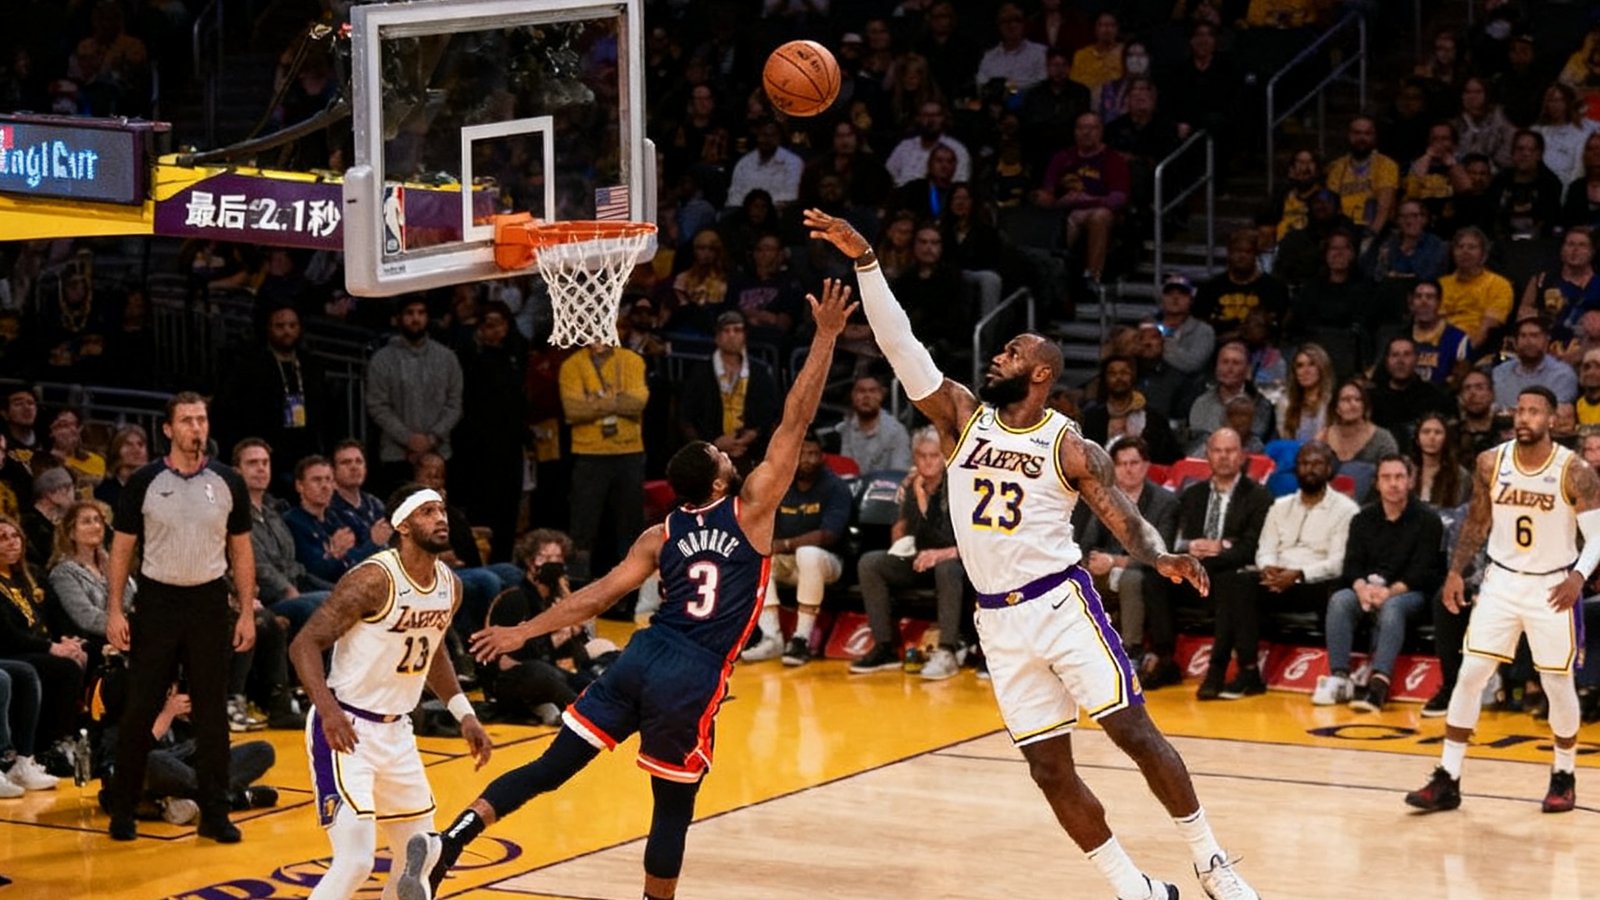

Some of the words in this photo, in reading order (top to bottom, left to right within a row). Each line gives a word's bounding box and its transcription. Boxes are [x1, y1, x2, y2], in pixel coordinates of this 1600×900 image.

[185, 190, 341, 237] 最后2.1秒
[972, 477, 1025, 533] 23
[1515, 515, 1533, 548] 6
[685, 561, 719, 618] 3
